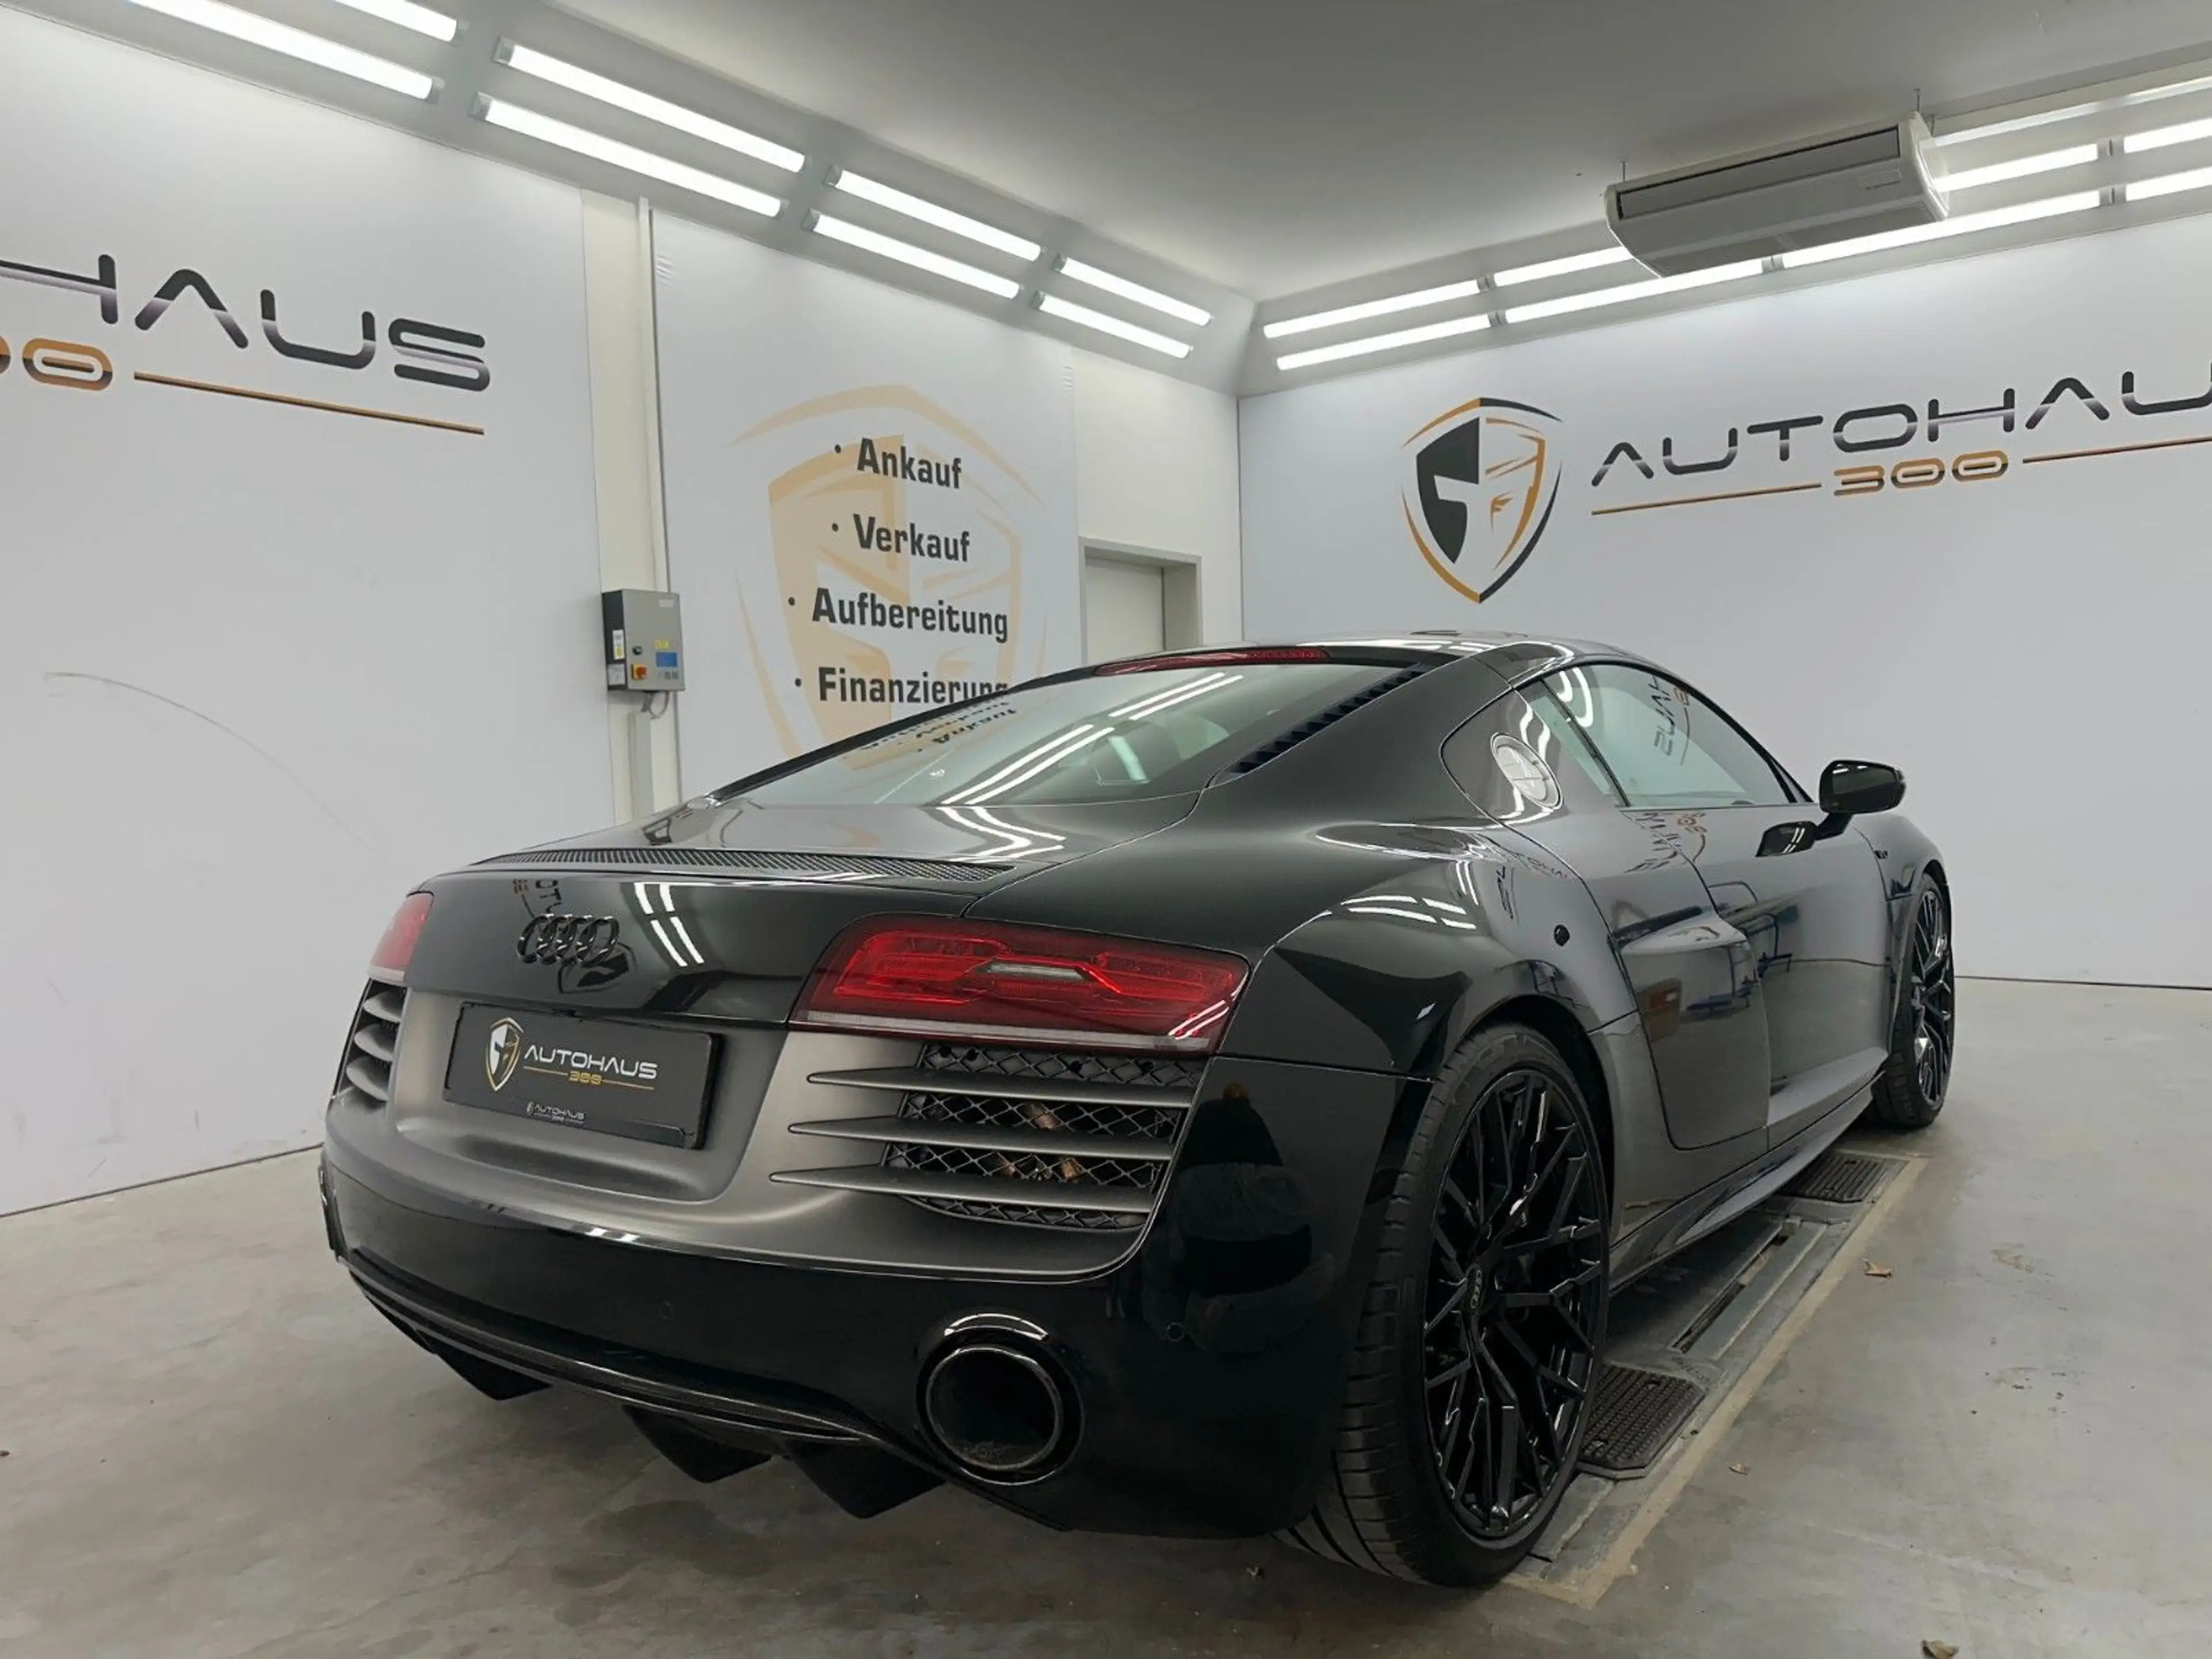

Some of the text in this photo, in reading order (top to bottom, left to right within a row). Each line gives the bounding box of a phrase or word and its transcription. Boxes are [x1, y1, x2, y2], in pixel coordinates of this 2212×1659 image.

[857, 438, 961, 489] Ankauf
[1834, 450, 2009, 497] 300
[853, 513, 970, 562] Verkauf
[812, 587, 1008, 644] Aufbereitung
[818, 666, 1008, 703] Finanzierun
[523, 1044, 658, 1080] AUTOHAUS
